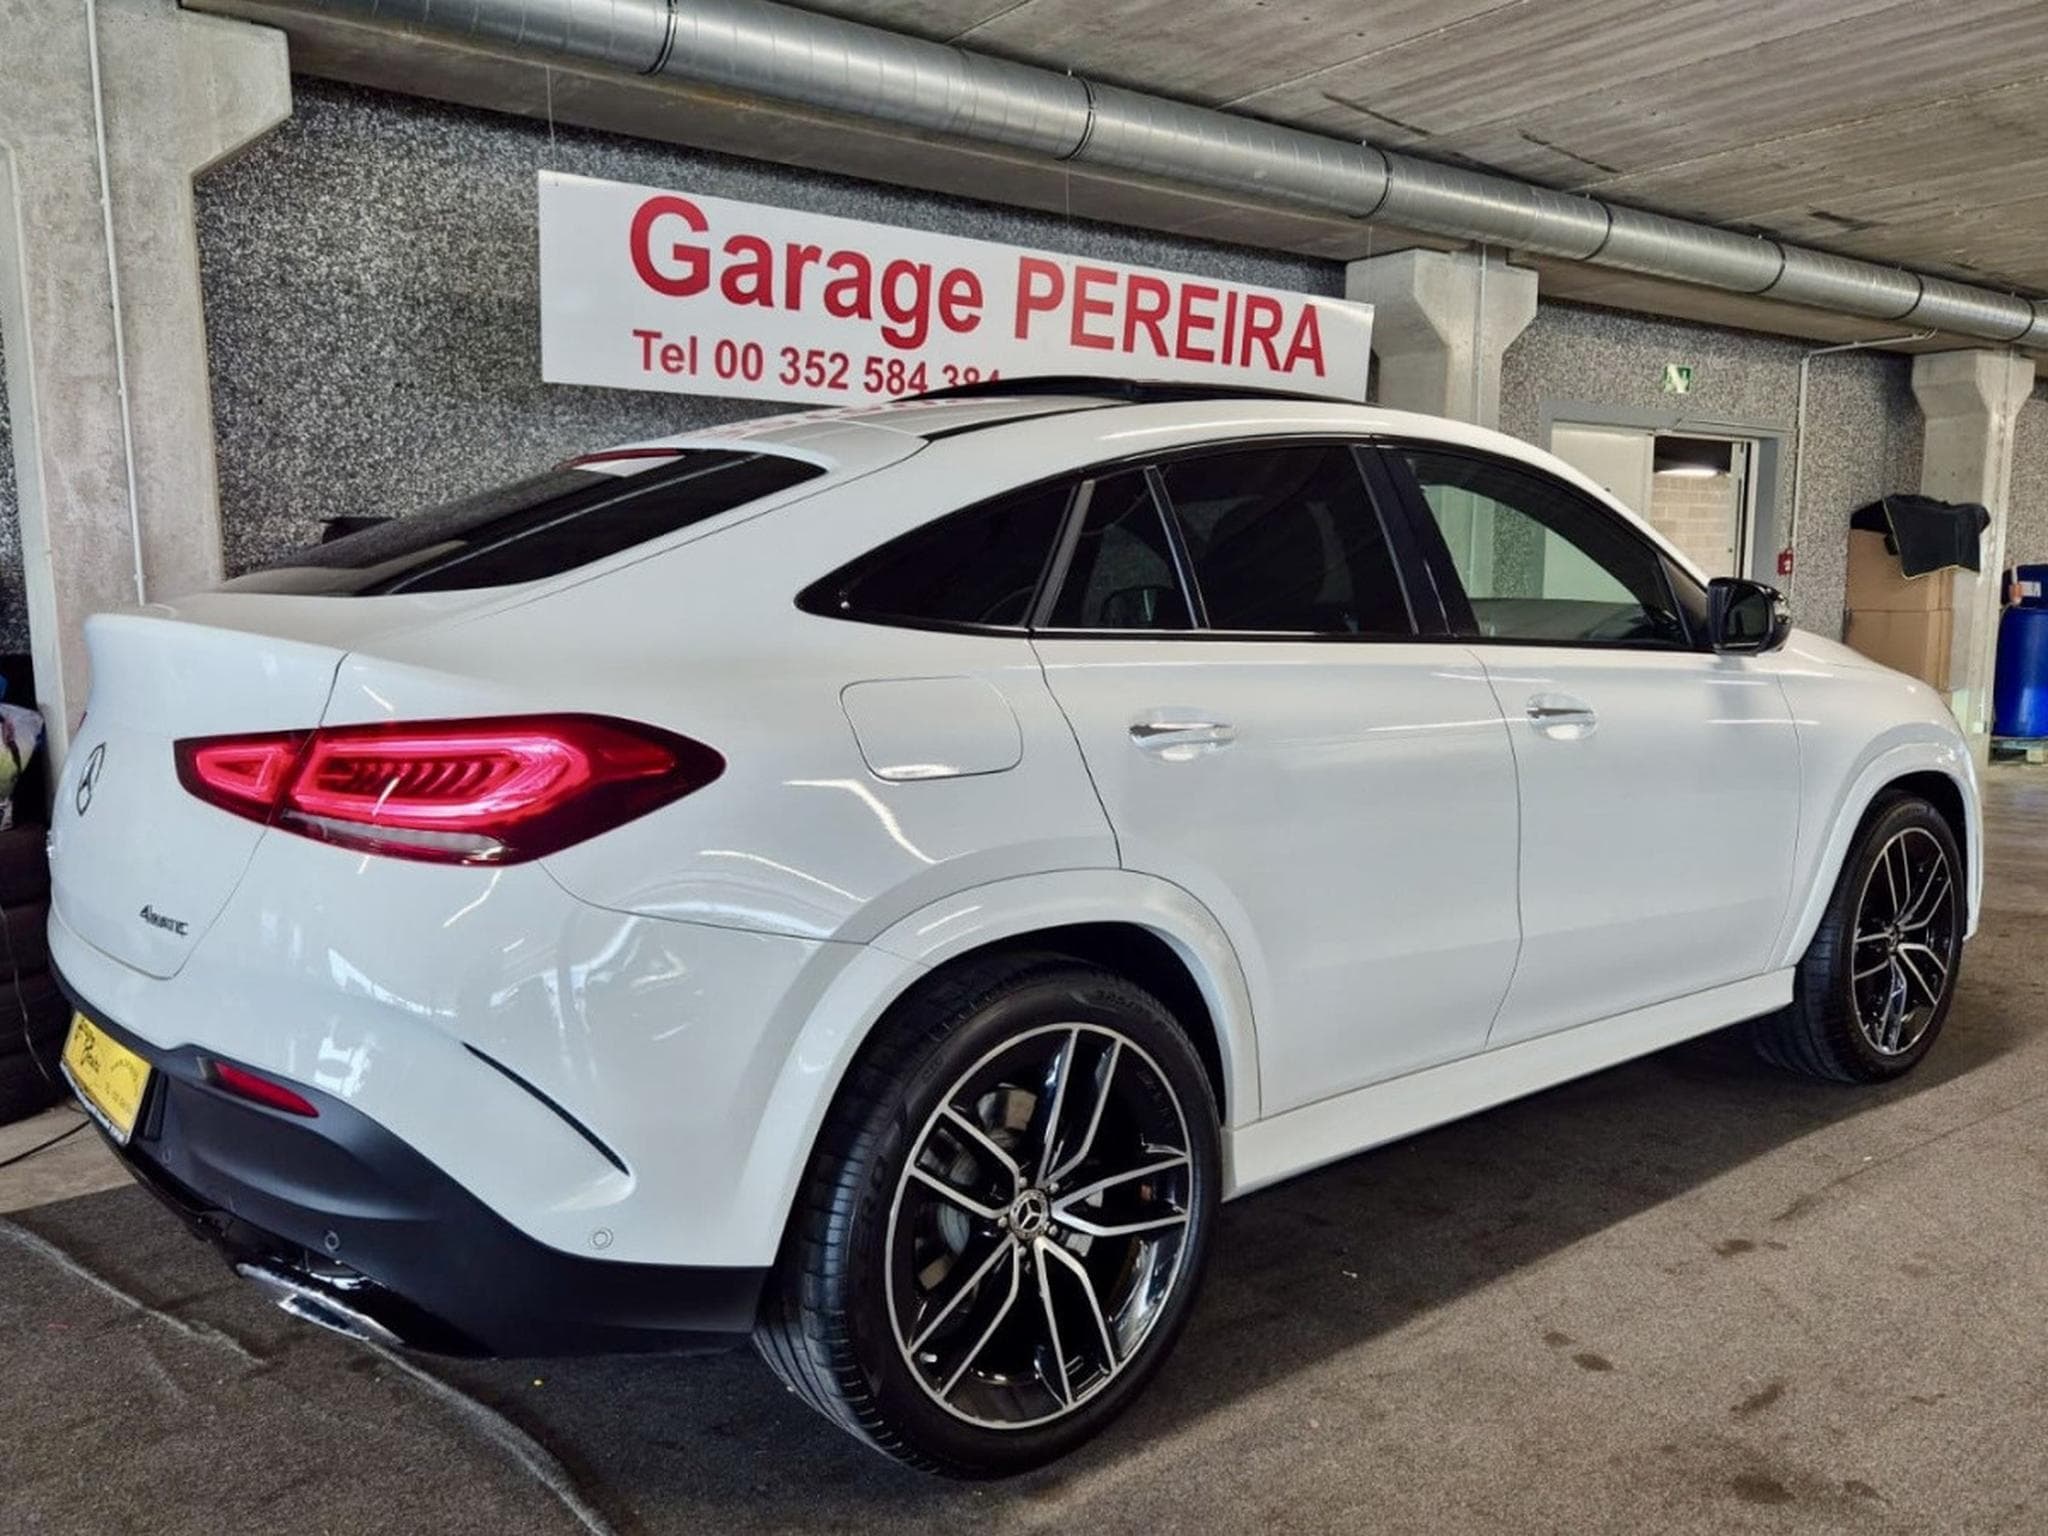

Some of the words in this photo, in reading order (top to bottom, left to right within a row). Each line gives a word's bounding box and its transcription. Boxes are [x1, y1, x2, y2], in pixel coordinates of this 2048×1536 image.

[629, 195, 984, 351] Garage
[1015, 257, 1326, 378] PEREIRA
[632, 329, 698, 375] Tel
[714, 339, 764, 381] 00
[779, 346, 849, 390] 352
[863, 356, 928, 395] 584
